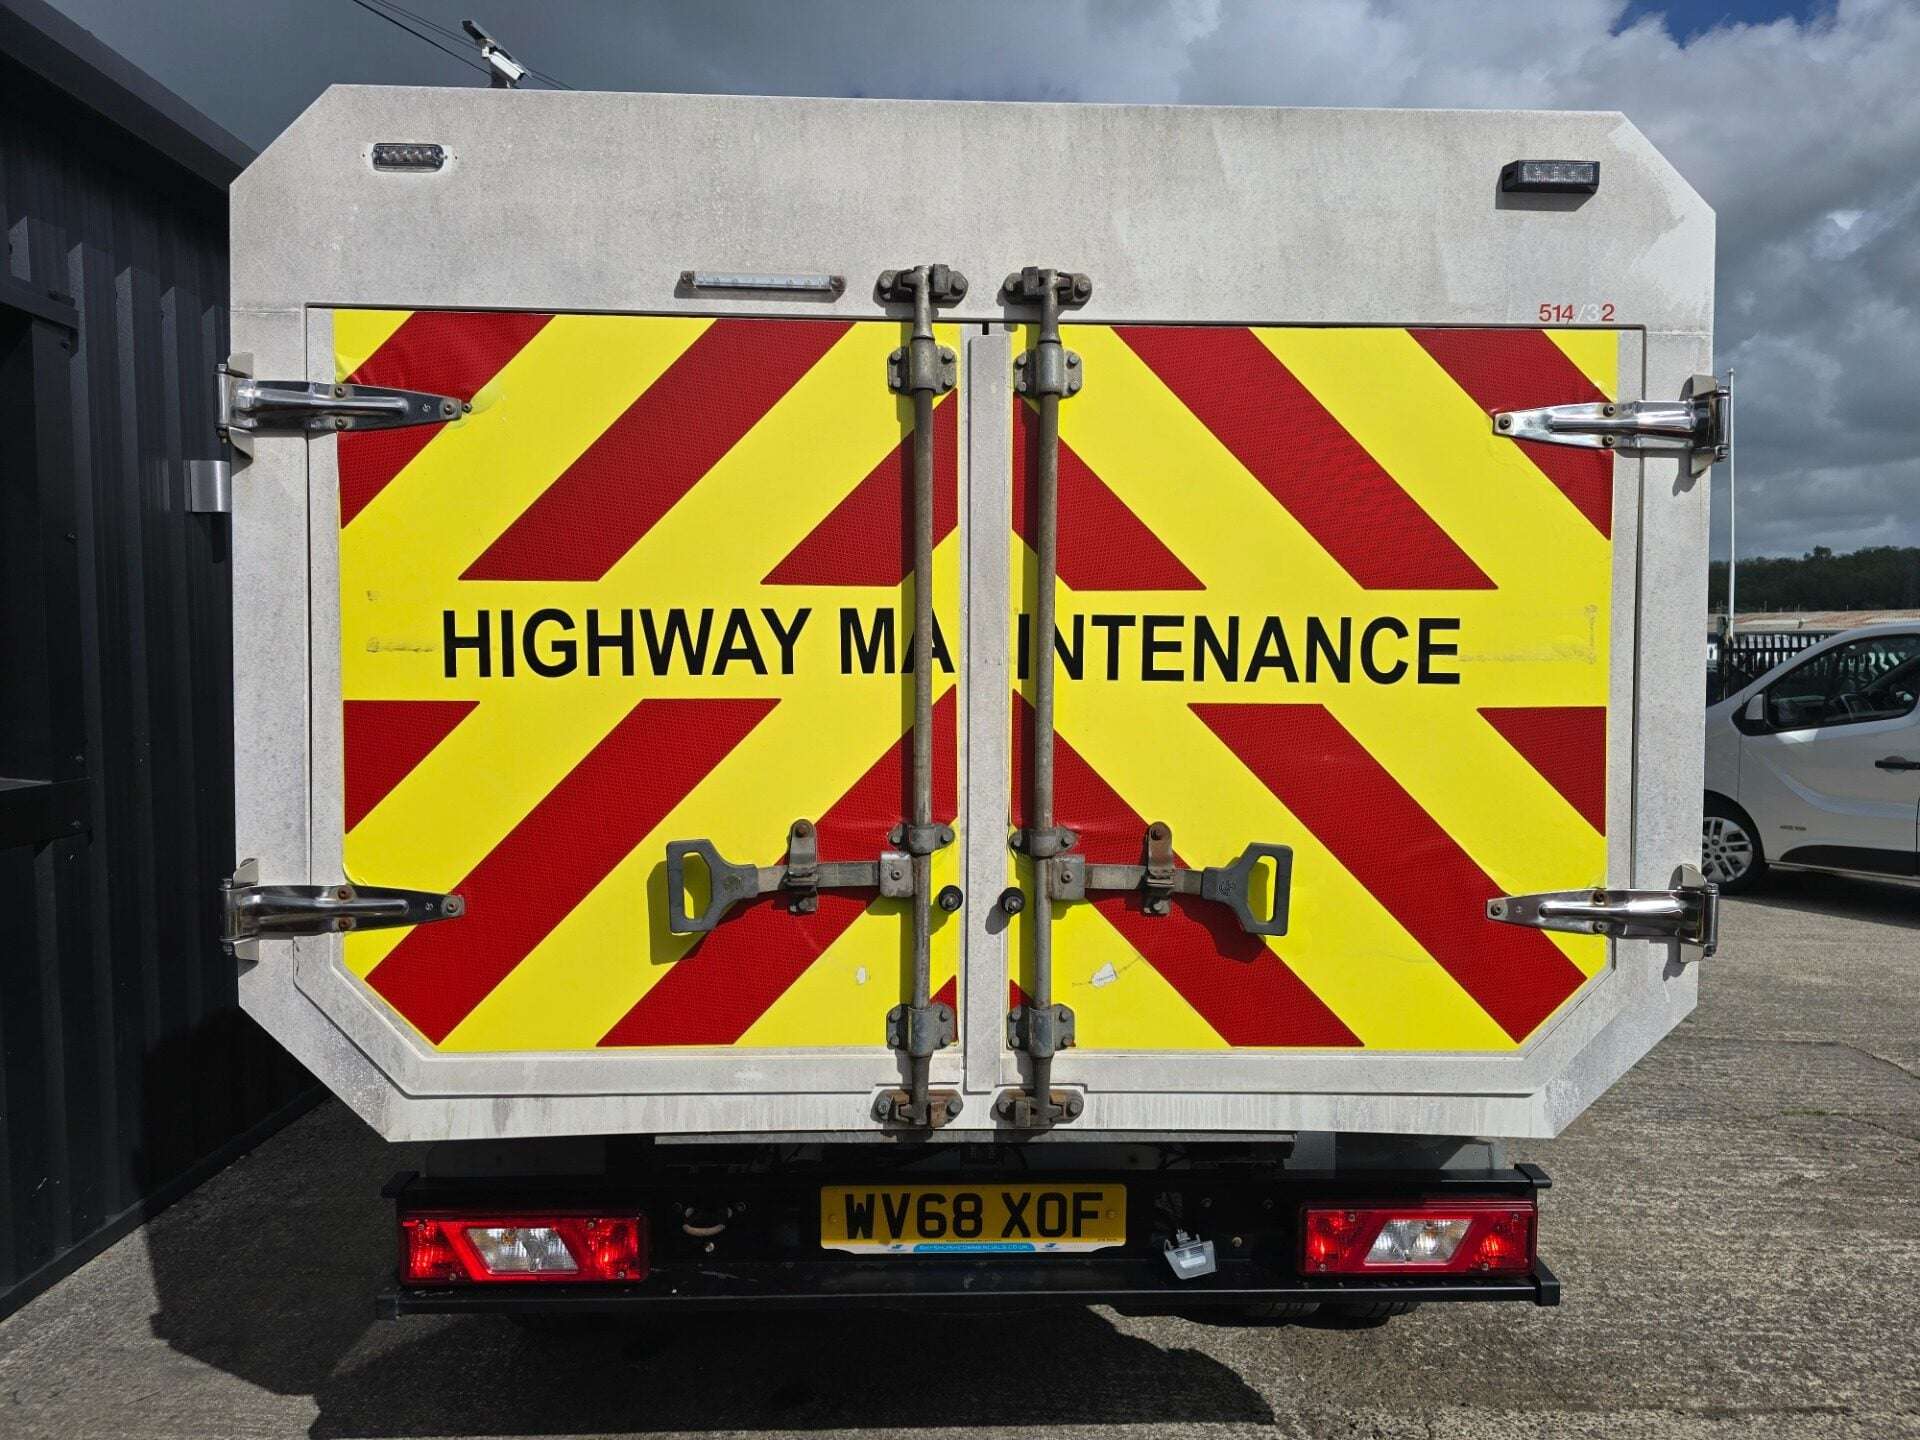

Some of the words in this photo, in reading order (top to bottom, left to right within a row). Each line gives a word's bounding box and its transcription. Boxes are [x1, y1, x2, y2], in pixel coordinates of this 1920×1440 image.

[443, 607, 812, 678] HIGHWAY
[844, 1191, 983, 1240] WV68
[1000, 1191, 1104, 1239] XOF
